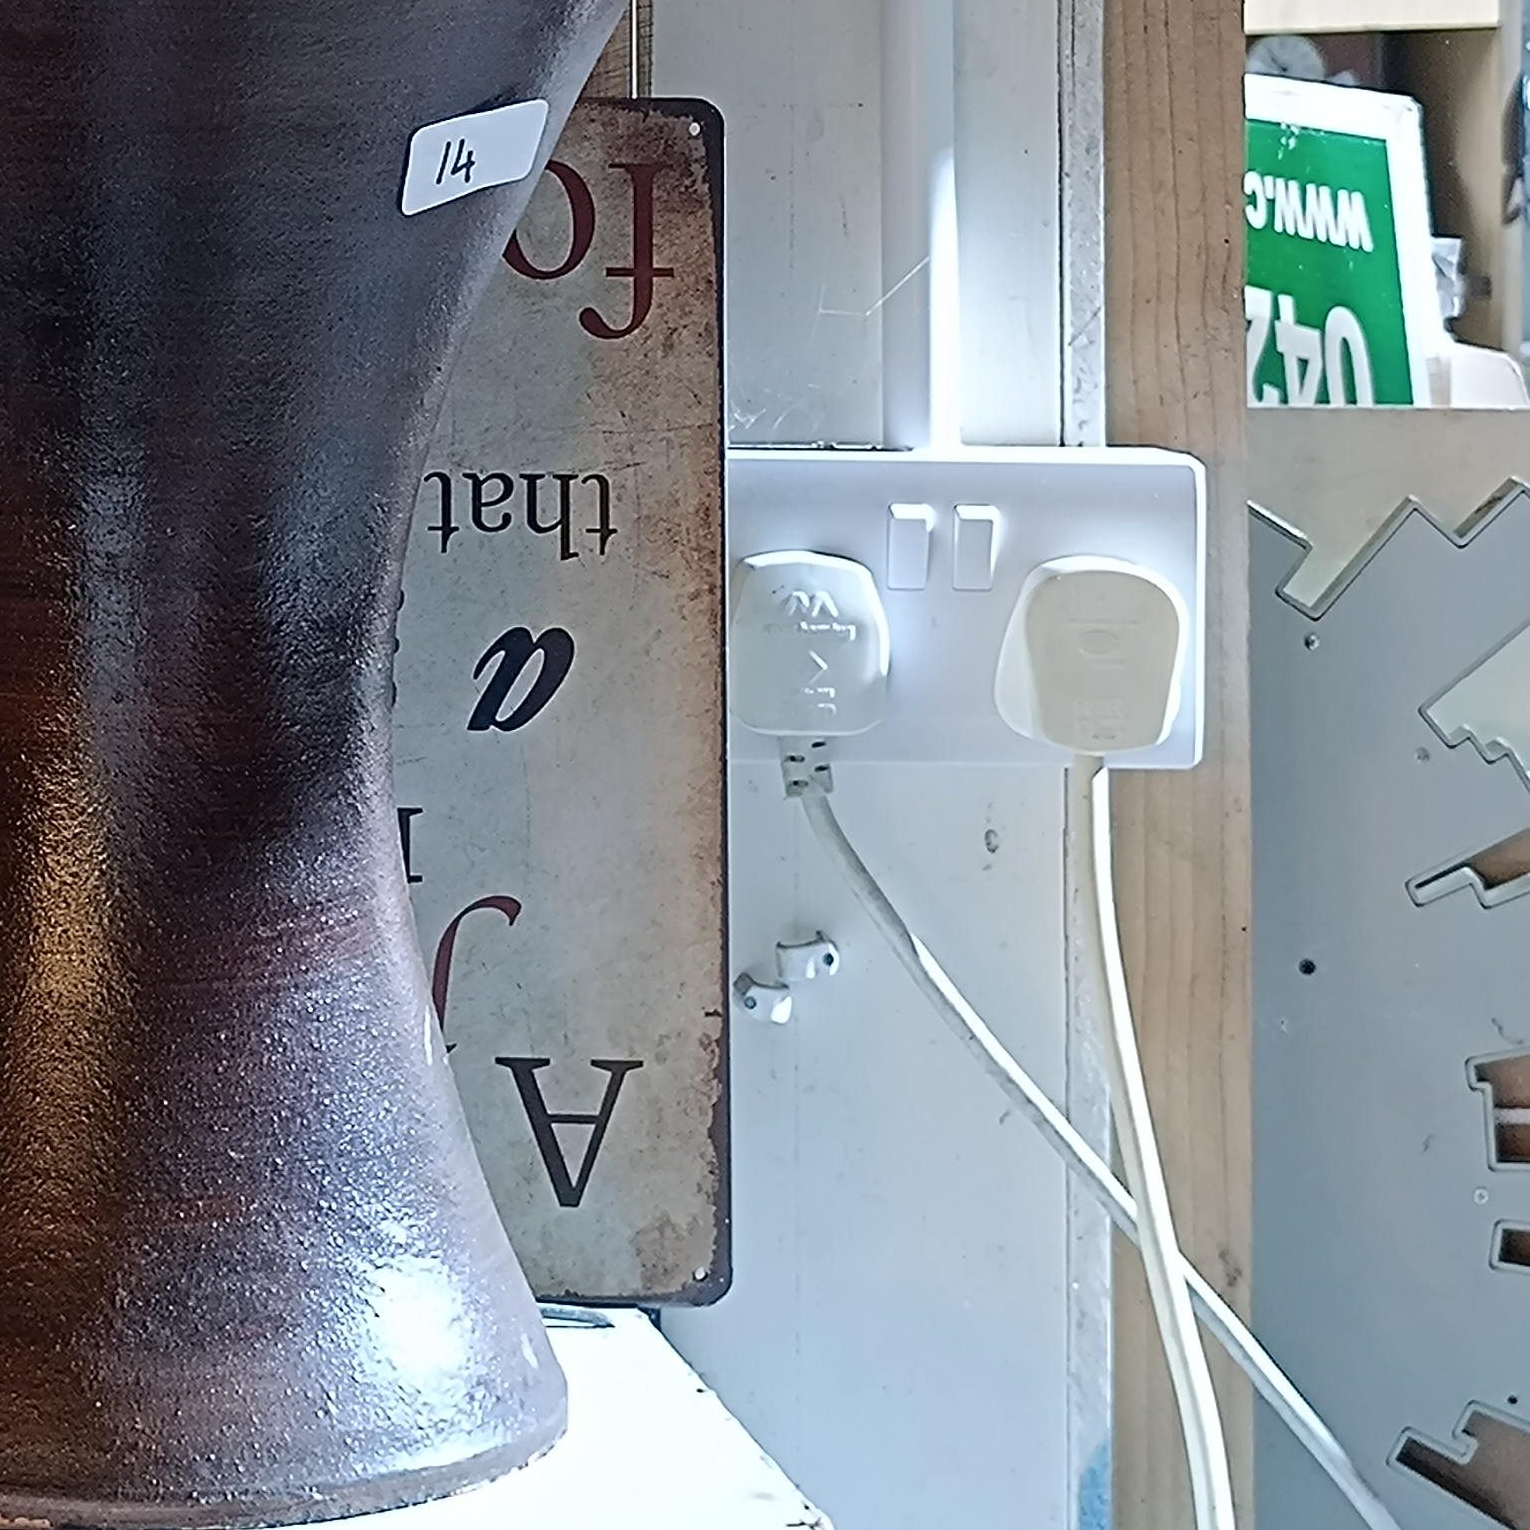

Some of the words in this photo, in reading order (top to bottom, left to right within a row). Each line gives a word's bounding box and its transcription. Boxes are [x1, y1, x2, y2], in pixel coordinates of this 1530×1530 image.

[435, 138, 475, 185] 14
[424, 471, 617, 560] that
[468, 625, 575, 732] a
[495, 1056, 644, 1208] A
